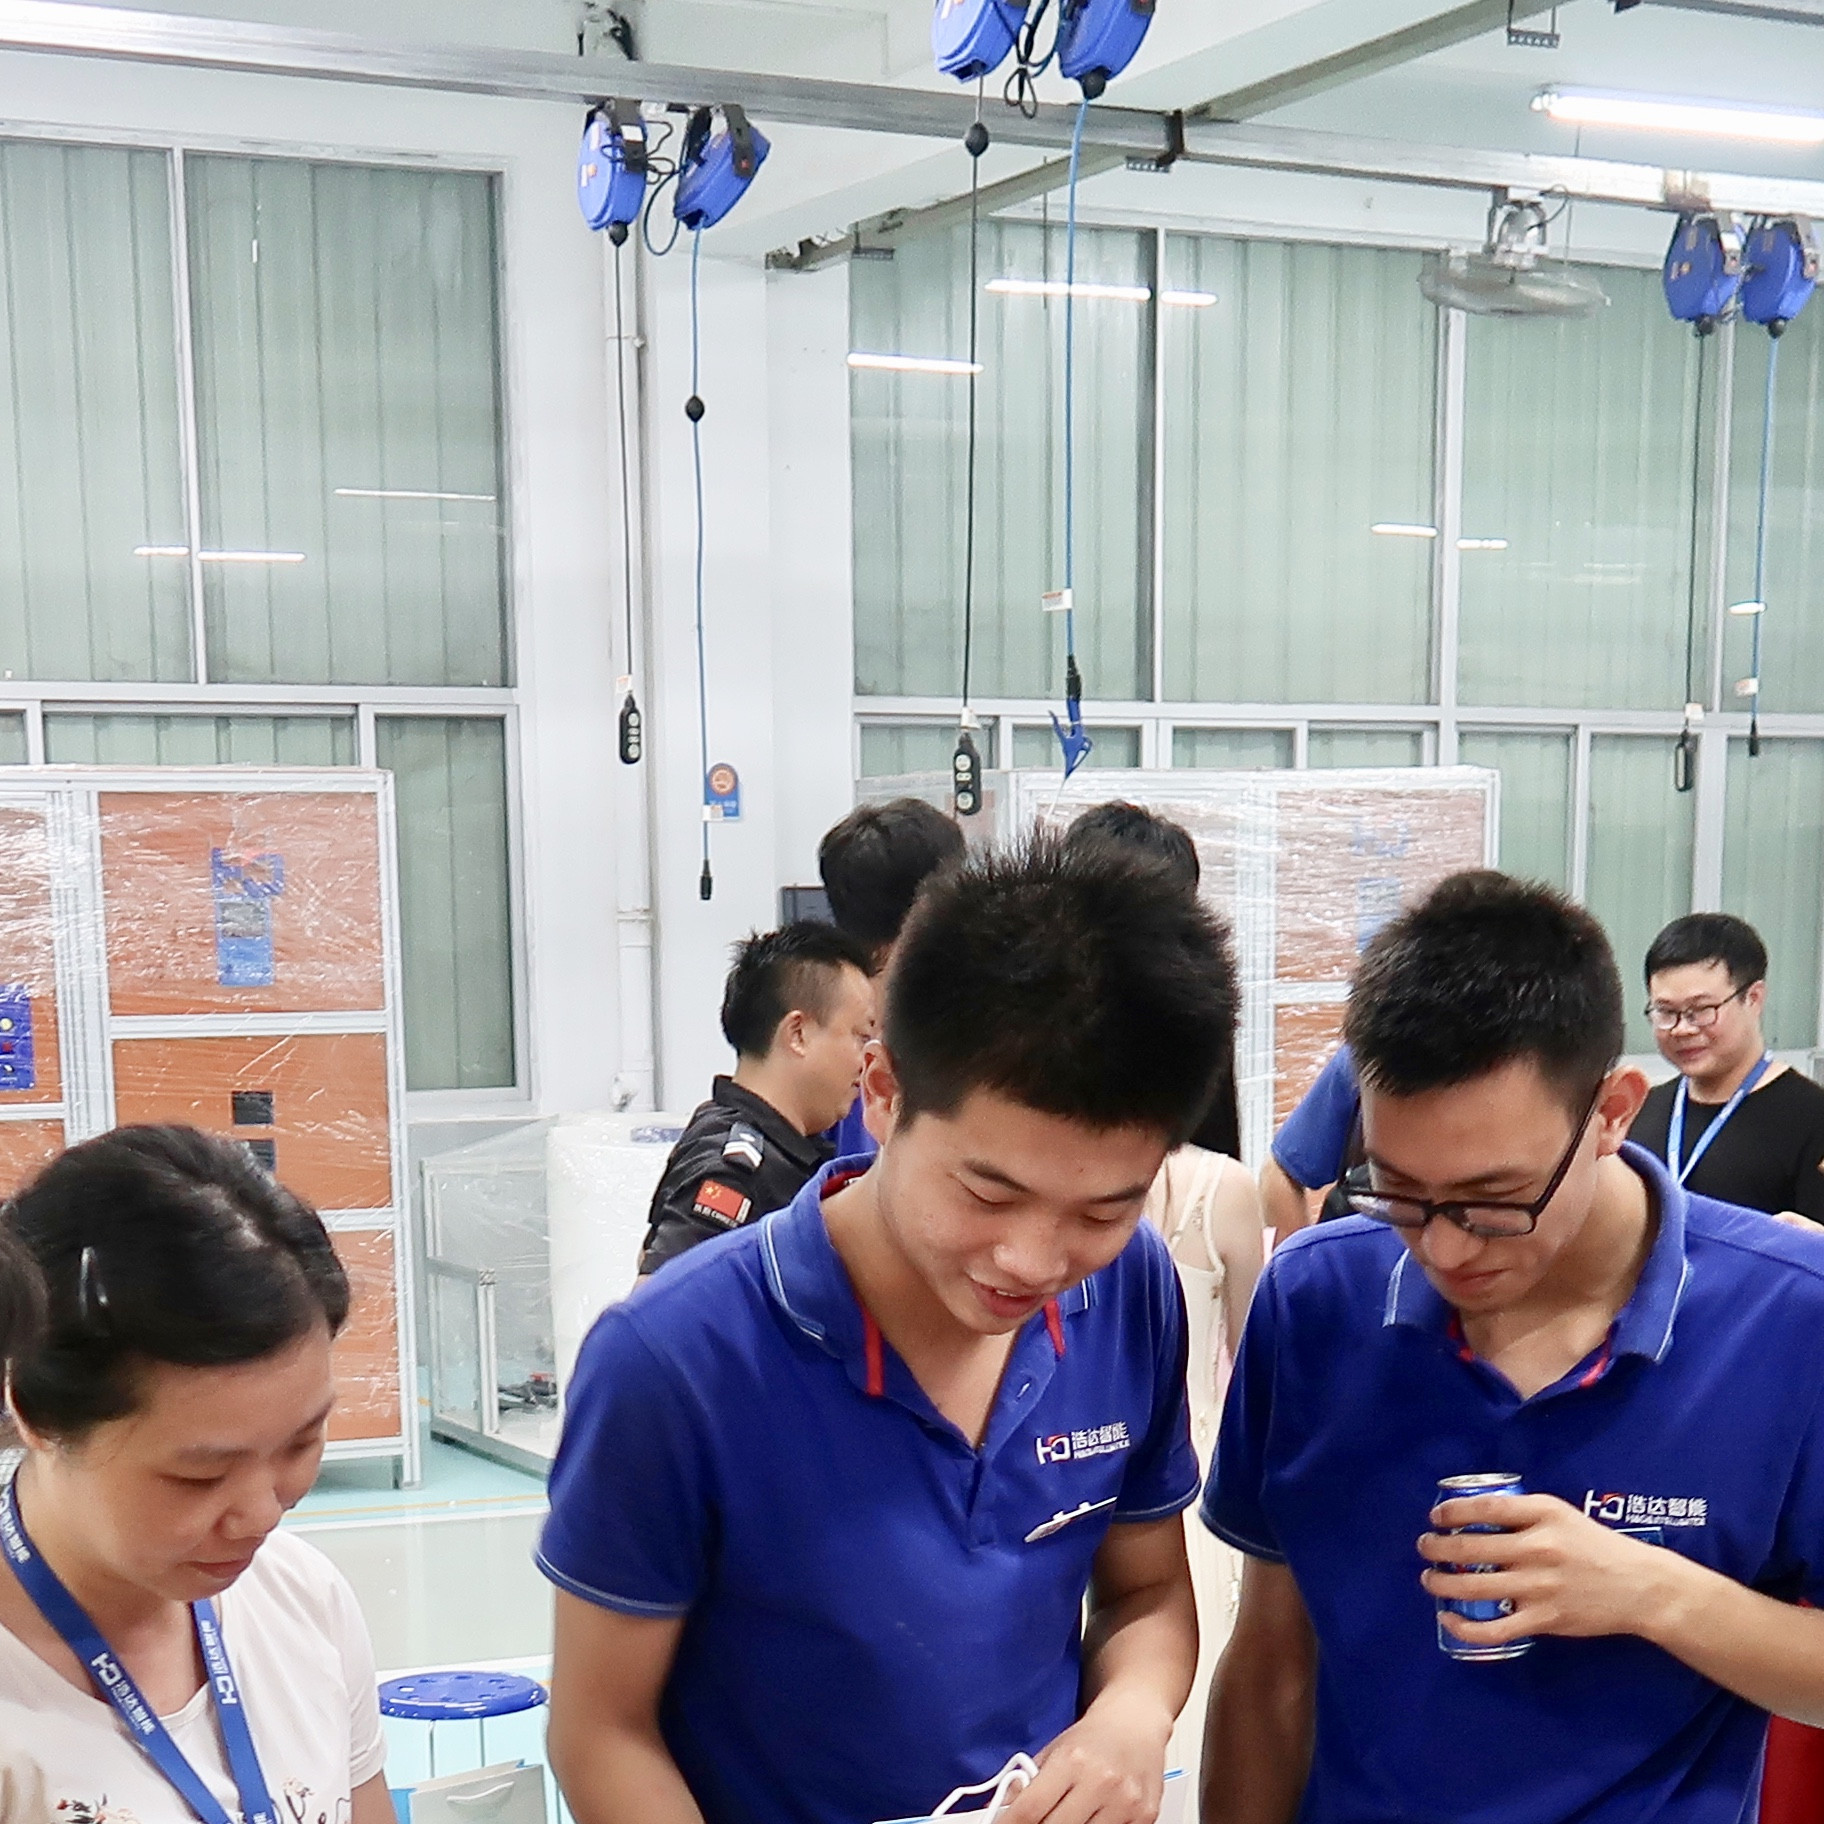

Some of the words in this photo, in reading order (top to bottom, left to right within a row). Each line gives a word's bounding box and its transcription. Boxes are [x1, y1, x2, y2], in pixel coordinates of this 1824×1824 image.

[1071, 1421, 1129, 1450] 浩达智能
[1626, 1494, 1708, 1517] 浩达智能
